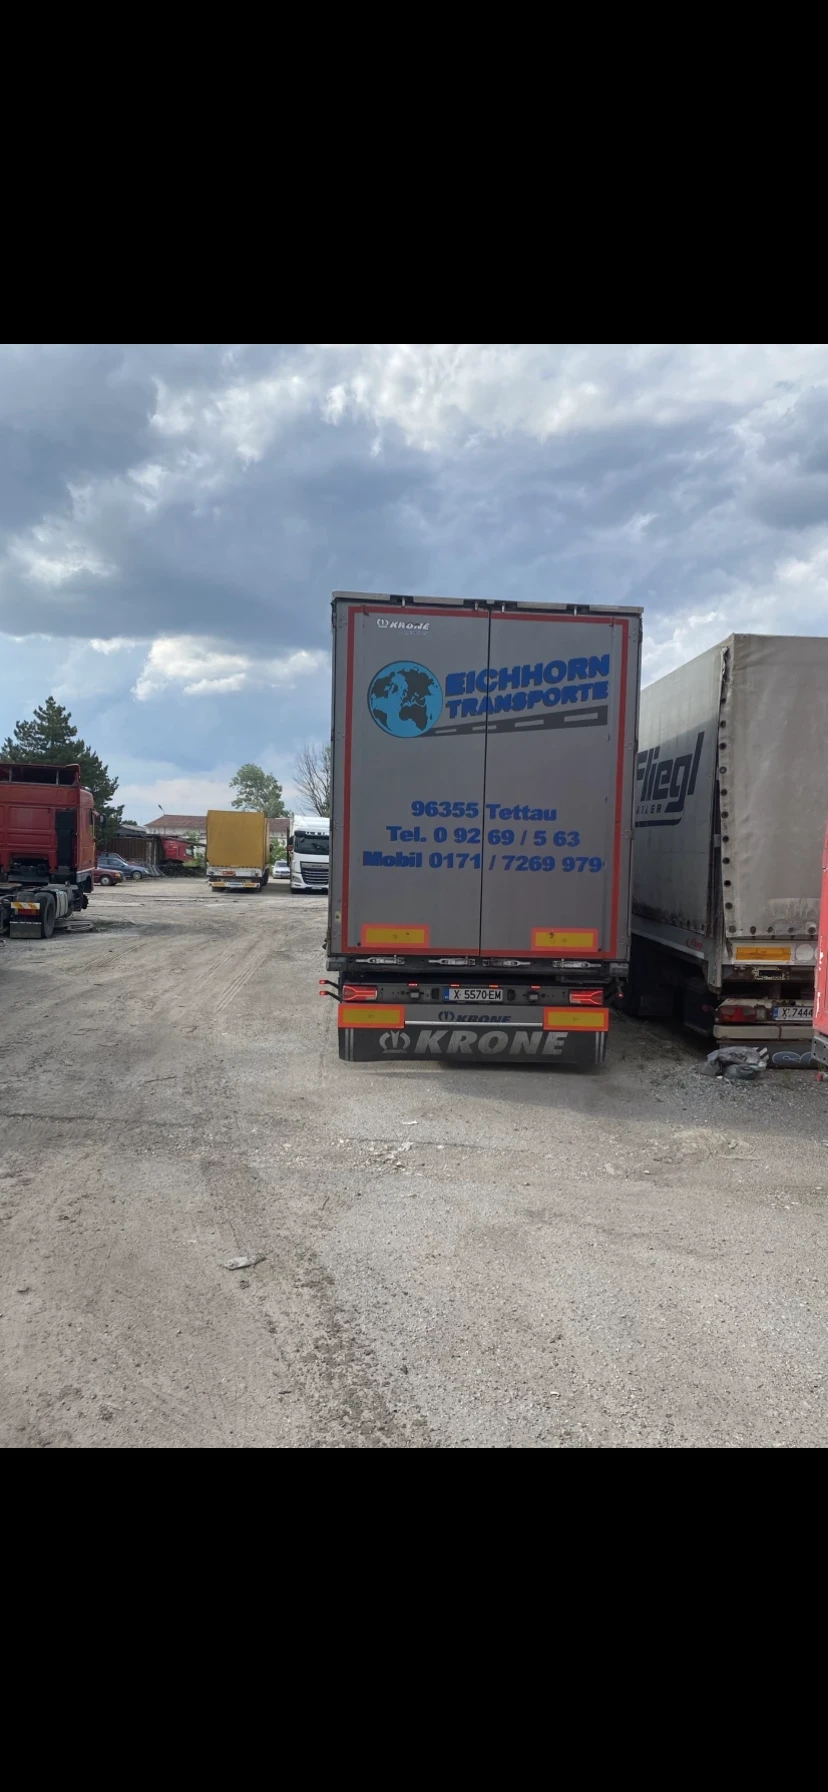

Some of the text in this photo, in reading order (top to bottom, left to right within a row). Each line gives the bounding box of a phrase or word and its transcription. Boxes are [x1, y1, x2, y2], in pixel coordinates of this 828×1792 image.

[445, 653, 611, 696] EICHHORN
[445, 680, 609, 719] TRANSPORTE
[411, 800, 558, 822] 96355 Tettau
[386, 825, 580, 848] Tel. 0 92 69 / 5 63
[362, 851, 602, 873] Mobil 0171 / 7269 979
[456, 1014, 512, 1023] KRONE
[412, 1029, 570, 1055] KRONE
